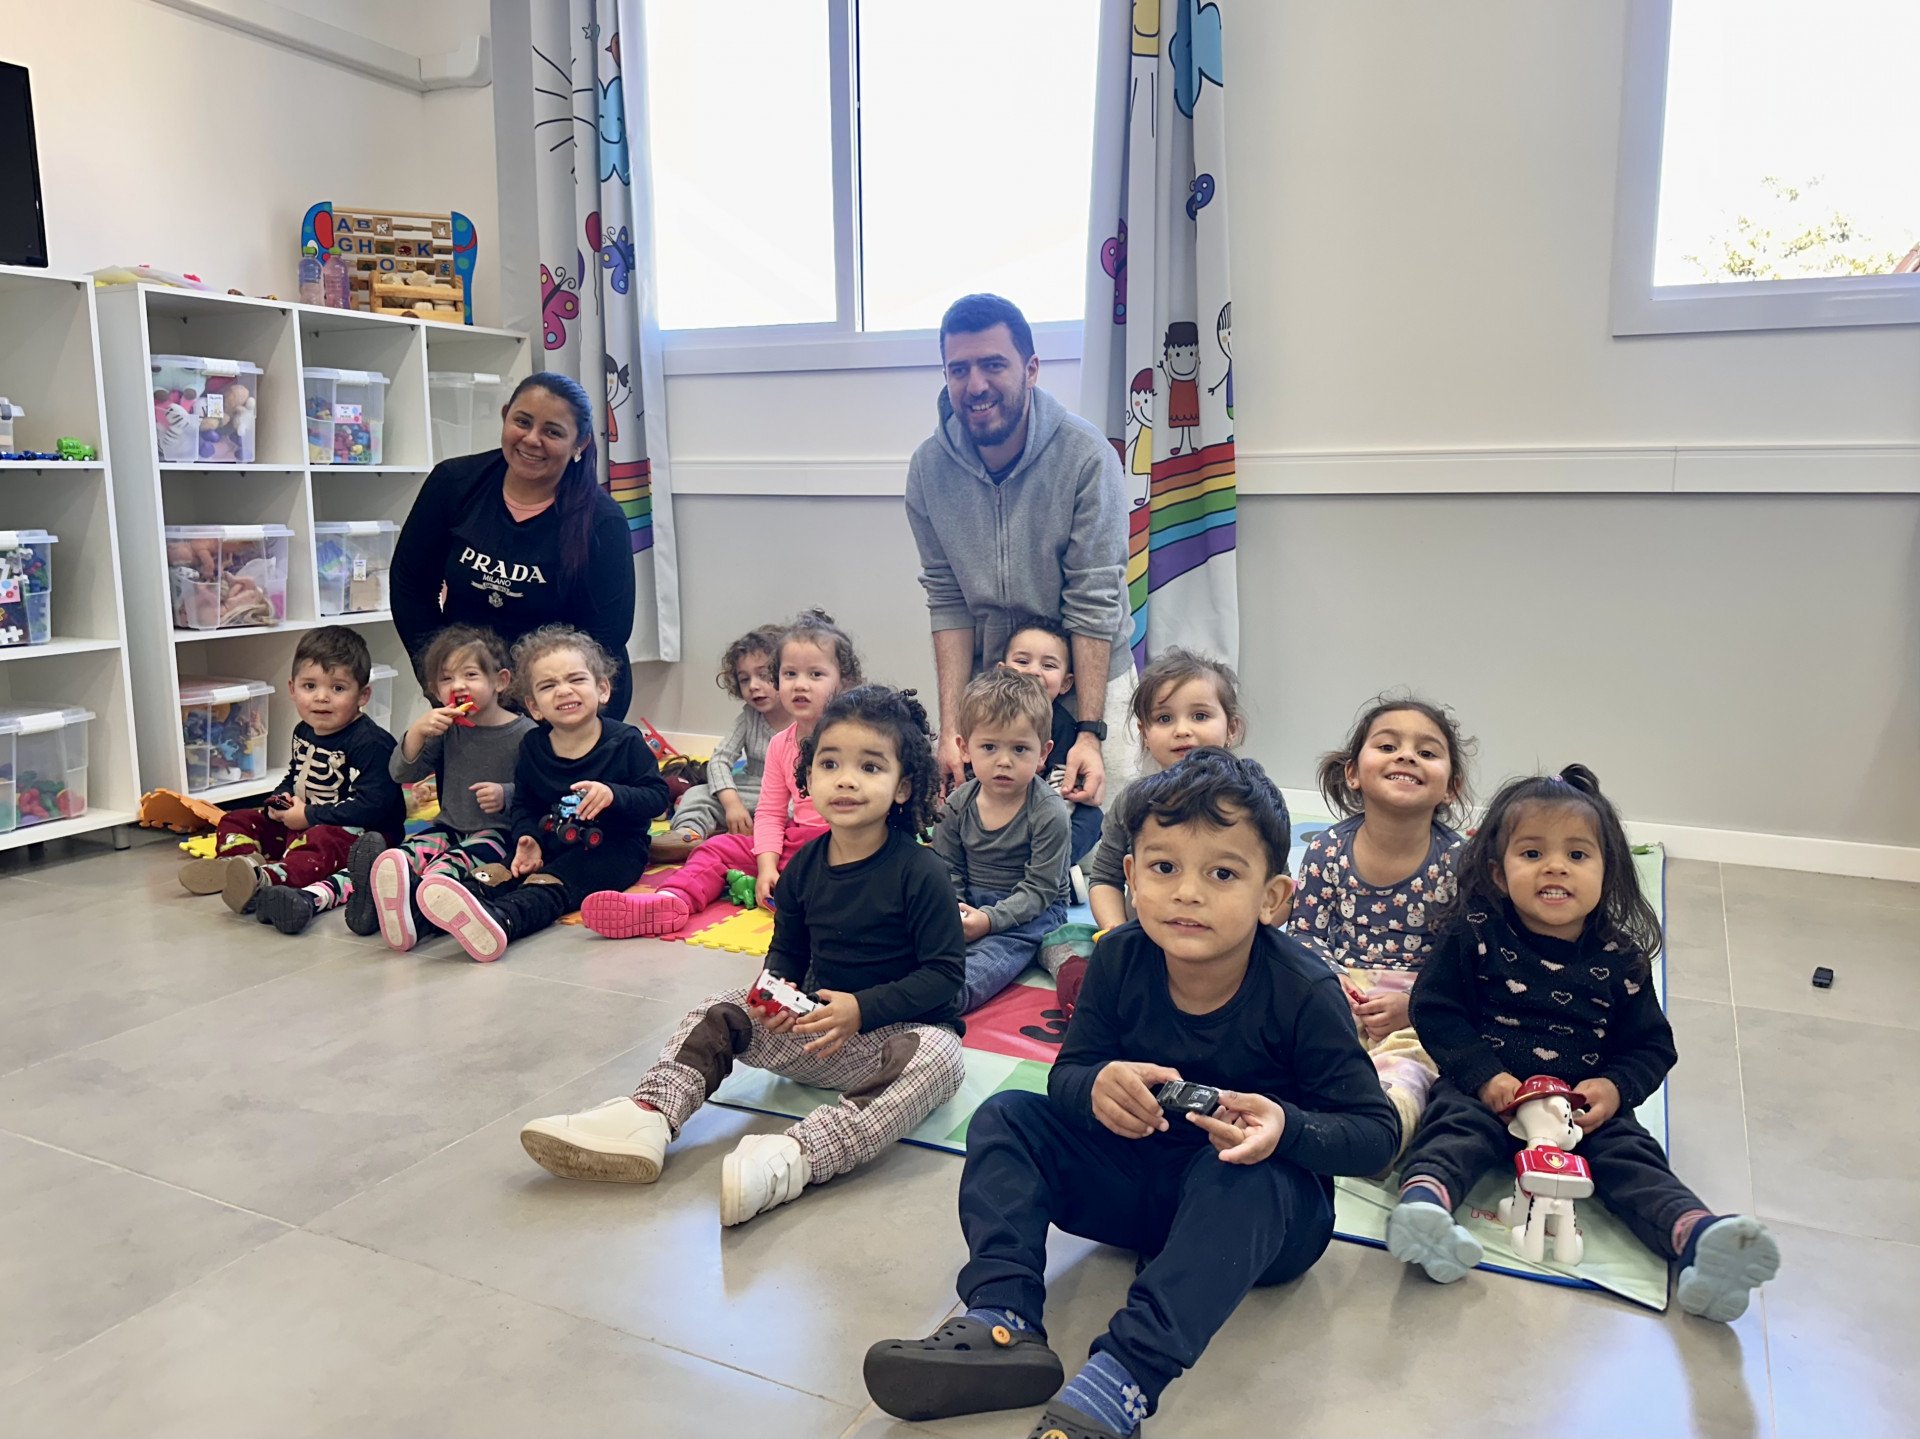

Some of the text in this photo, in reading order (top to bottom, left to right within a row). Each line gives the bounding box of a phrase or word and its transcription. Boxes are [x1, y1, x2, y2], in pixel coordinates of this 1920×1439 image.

[337, 217, 371, 231] A B
[338, 237, 431, 257] G H K
[459, 546, 547, 584] PRADA
[482, 573, 512, 588] MILANO
